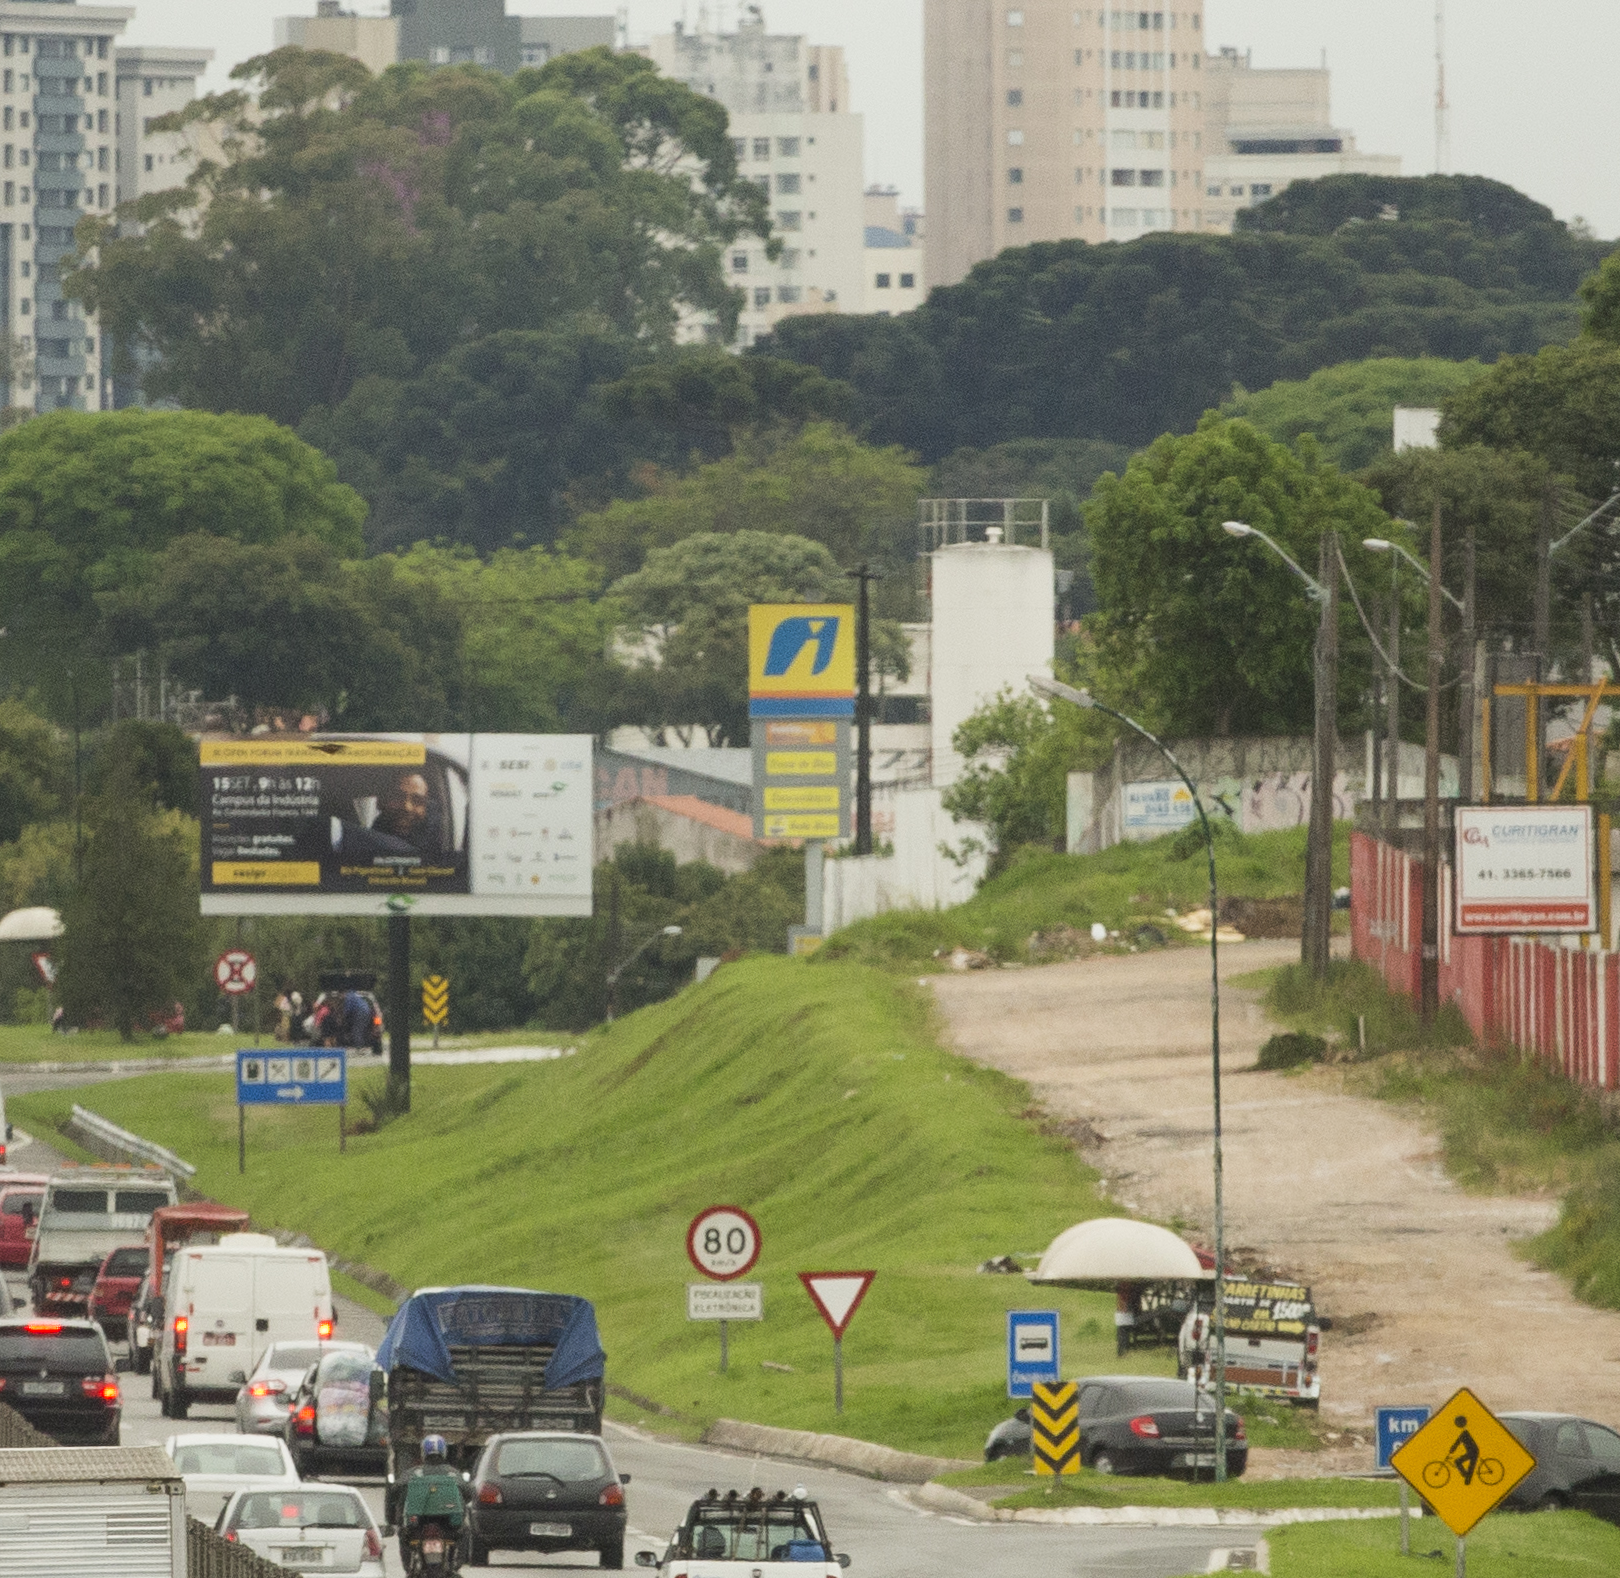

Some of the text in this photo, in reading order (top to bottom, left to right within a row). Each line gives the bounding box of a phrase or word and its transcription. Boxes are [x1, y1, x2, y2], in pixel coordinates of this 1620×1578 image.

[1492, 824, 1580, 837] CURITIGRAN
[704, 1227, 746, 1255] 80
[693, 1289, 758, 1300] FISCALIZAÇÃO
[693, 1301, 757, 1313] ELETRÔNICA
[1388, 1416, 1419, 1434] km
